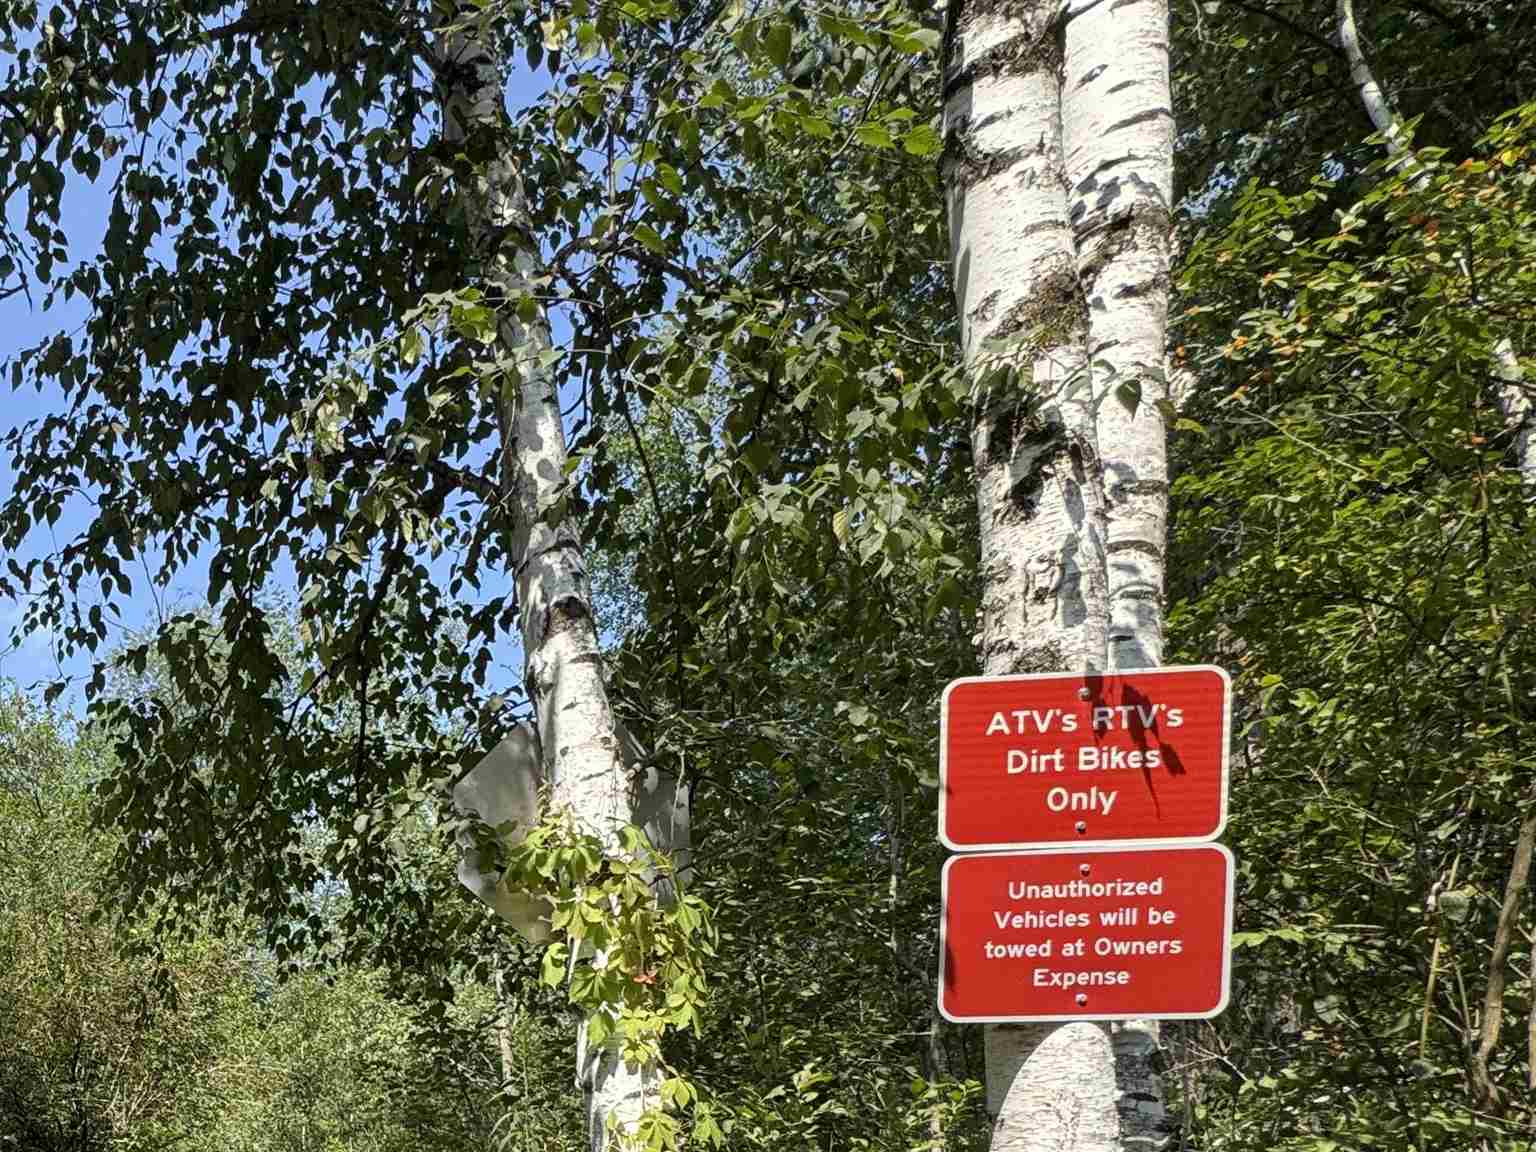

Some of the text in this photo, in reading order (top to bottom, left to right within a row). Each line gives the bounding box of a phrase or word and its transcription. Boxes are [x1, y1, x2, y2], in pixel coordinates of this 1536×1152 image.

[985, 703, 1184, 736] ATV's RTV's
[1007, 745, 1162, 775] Dirt Bikes
[1046, 785, 1118, 816] Only
[1008, 876, 1163, 900] Unauthorized
[993, 906, 1177, 929] Vehicles will be
[983, 937, 1183, 959] towed at Owners
[1033, 968, 1131, 990] Expense
